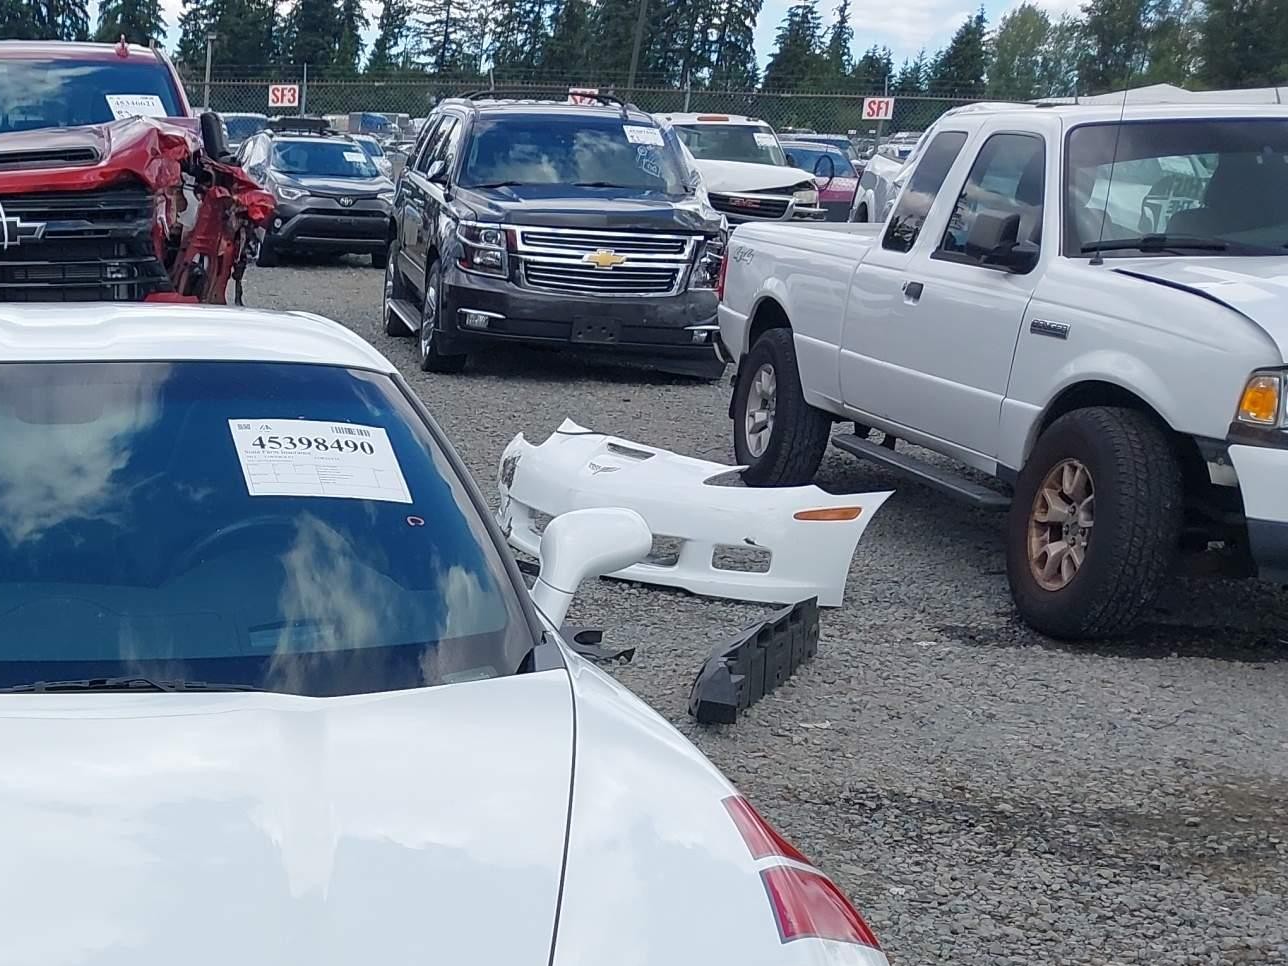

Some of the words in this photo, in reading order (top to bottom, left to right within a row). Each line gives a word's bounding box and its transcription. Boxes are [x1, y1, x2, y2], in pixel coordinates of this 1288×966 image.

[272, 87, 297, 104] SF3
[866, 100, 889, 117] SF1
[252, 435, 375, 456] 45398490
